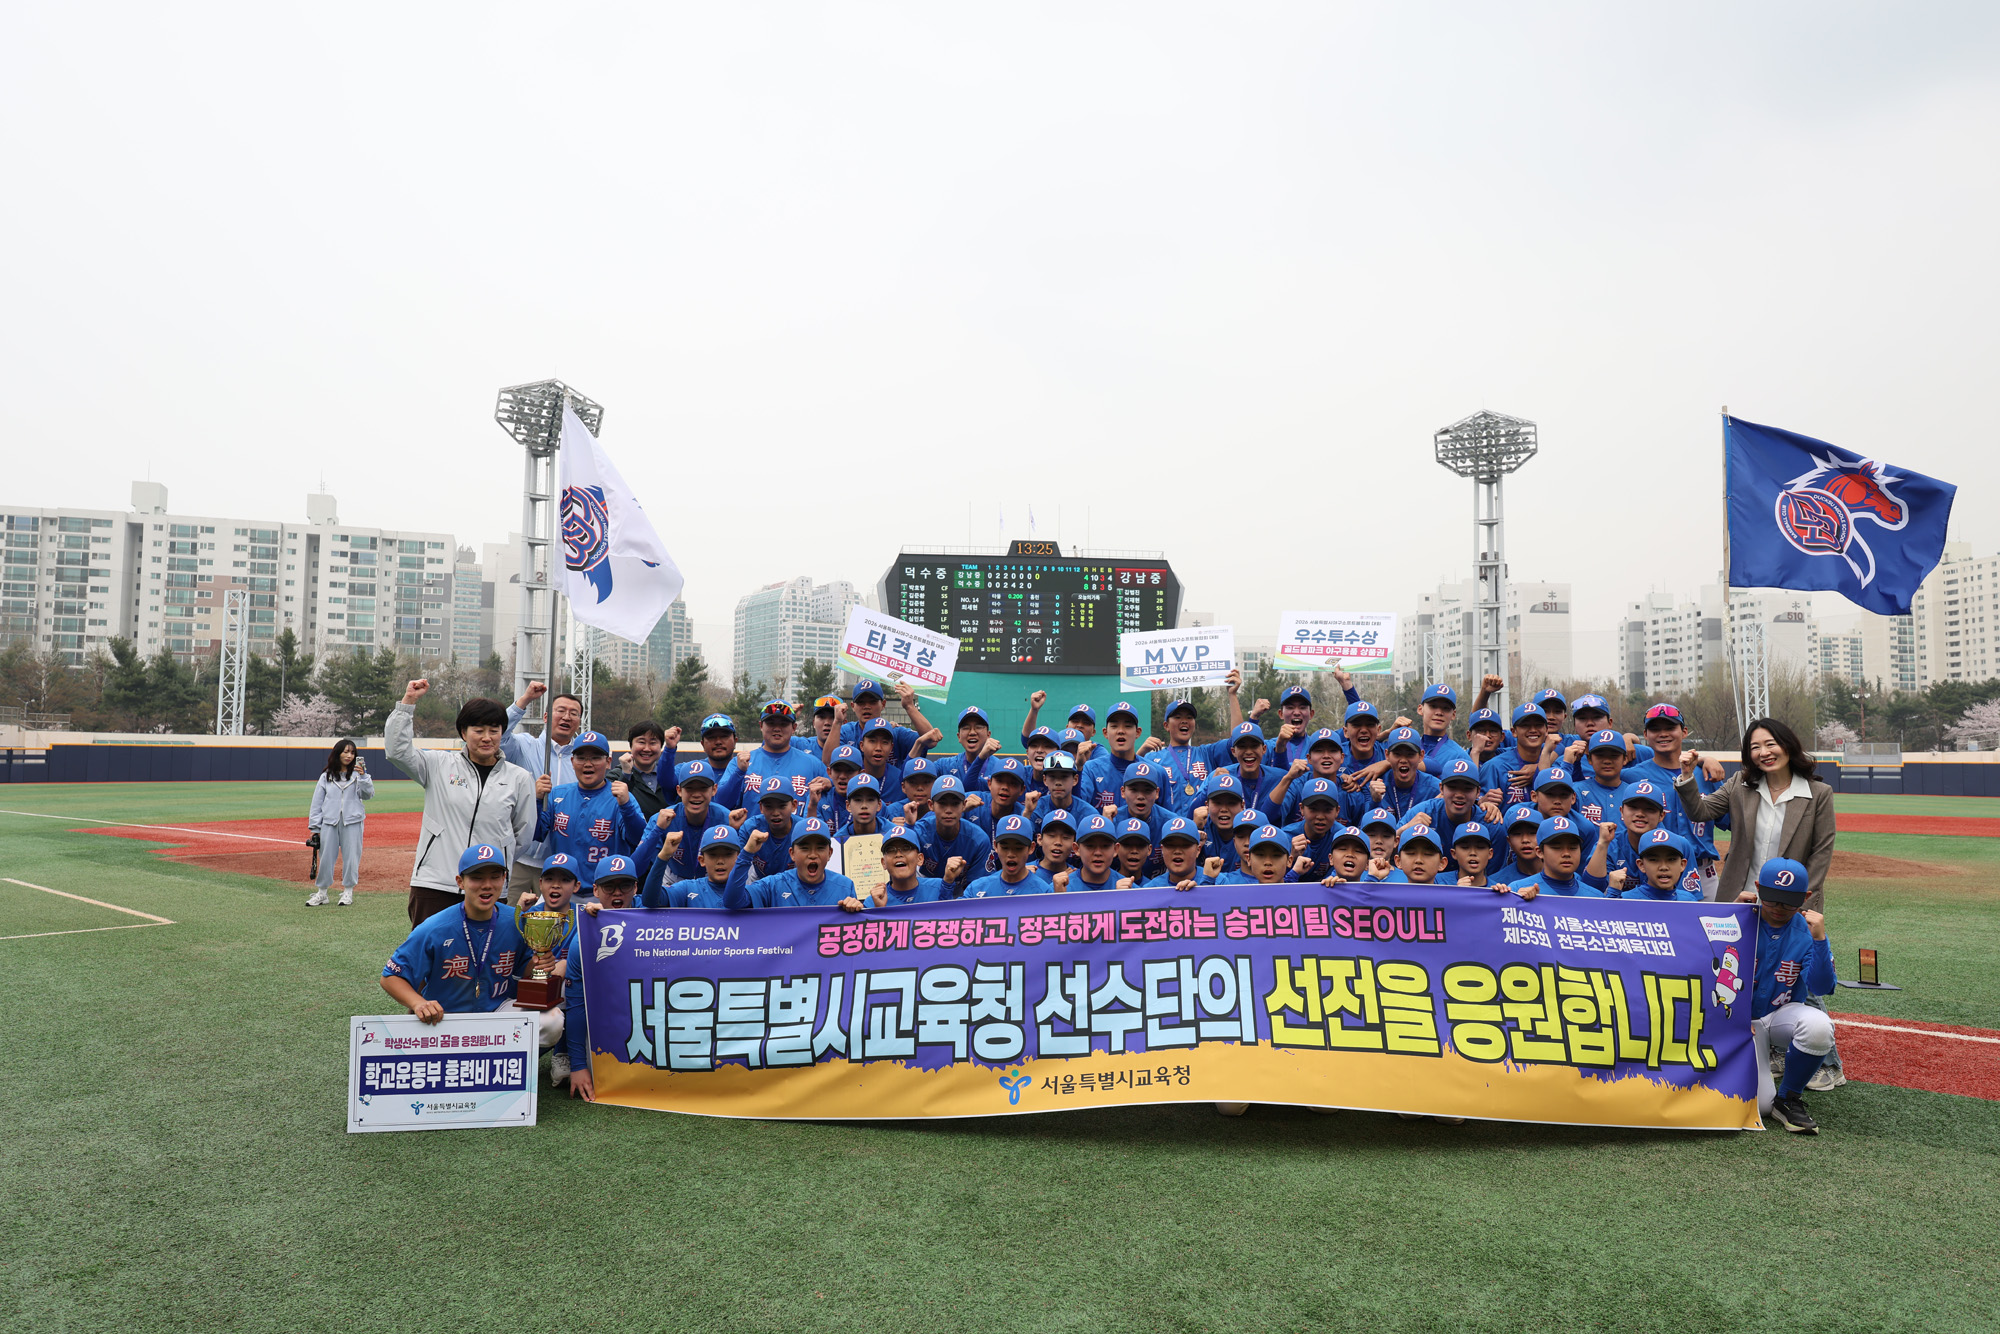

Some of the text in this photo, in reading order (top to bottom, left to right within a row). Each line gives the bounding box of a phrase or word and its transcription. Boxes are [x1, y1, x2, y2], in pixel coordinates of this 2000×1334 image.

[1017, 543, 1053, 555] 13:25
[1120, 572, 1161, 584] 강남중
[1542, 601, 1558, 611] 511
[864, 619, 878, 627] 2026
[1787, 611, 1803, 621] 510
[1294, 629, 1379, 645] 우수투수상
[866, 629, 936, 667] 타격상
[1145, 645, 1210, 665] MVP
[1284, 645, 1385, 657] 골드볼파크 야구용품 상품권
[849, 645, 944, 684] 골드볼파크 야구용품 상품권
[1133, 661, 1226, 675] 최고급 수제(WE) 글러브
[1166, 675, 1206, 685] KSM스포츠
[582, 732, 597, 743] D
[689, 761, 704, 775] D
[1453, 760, 1469, 774] D
[767, 778, 781, 791] D
[942, 777, 956, 789] D
[806, 818, 821, 832] D
[1006, 816, 1022, 831] D
[1090, 816, 1105, 829] D
[1554, 816, 1570, 830] D
[713, 826, 729, 840] D
[1261, 825, 1277, 839] D
[1774, 870, 1795, 887] D
[1501, 907, 1670, 938] 제43회 서울소년체육대회
[635, 926, 740, 941] 2026 BUSAN
[818, 904, 1446, 958] 공정하게 경쟁하고, 정직하게 도전하는 승리의 팀 SEOUL!
[1503, 927, 1676, 957] 제55회 전국소년체육대회
[634, 946, 793, 958] The National Junior Sports Festival
[491, 980, 509, 998] 10
[626, 954, 1718, 1072] 서울특별시교육청 선수단의 선전을 응원합니다.
[384, 1035, 439, 1050] 학생선수들의
[440, 1034, 460, 1048] 꿈을
[461, 1034, 506, 1048] 응원합니다
[365, 1057, 523, 1090] 학교운동부 훈련비 지원
[1040, 1065, 1191, 1096] 서울특별시교육청
[426, 1101, 477, 1110] 서울특별시교육청
